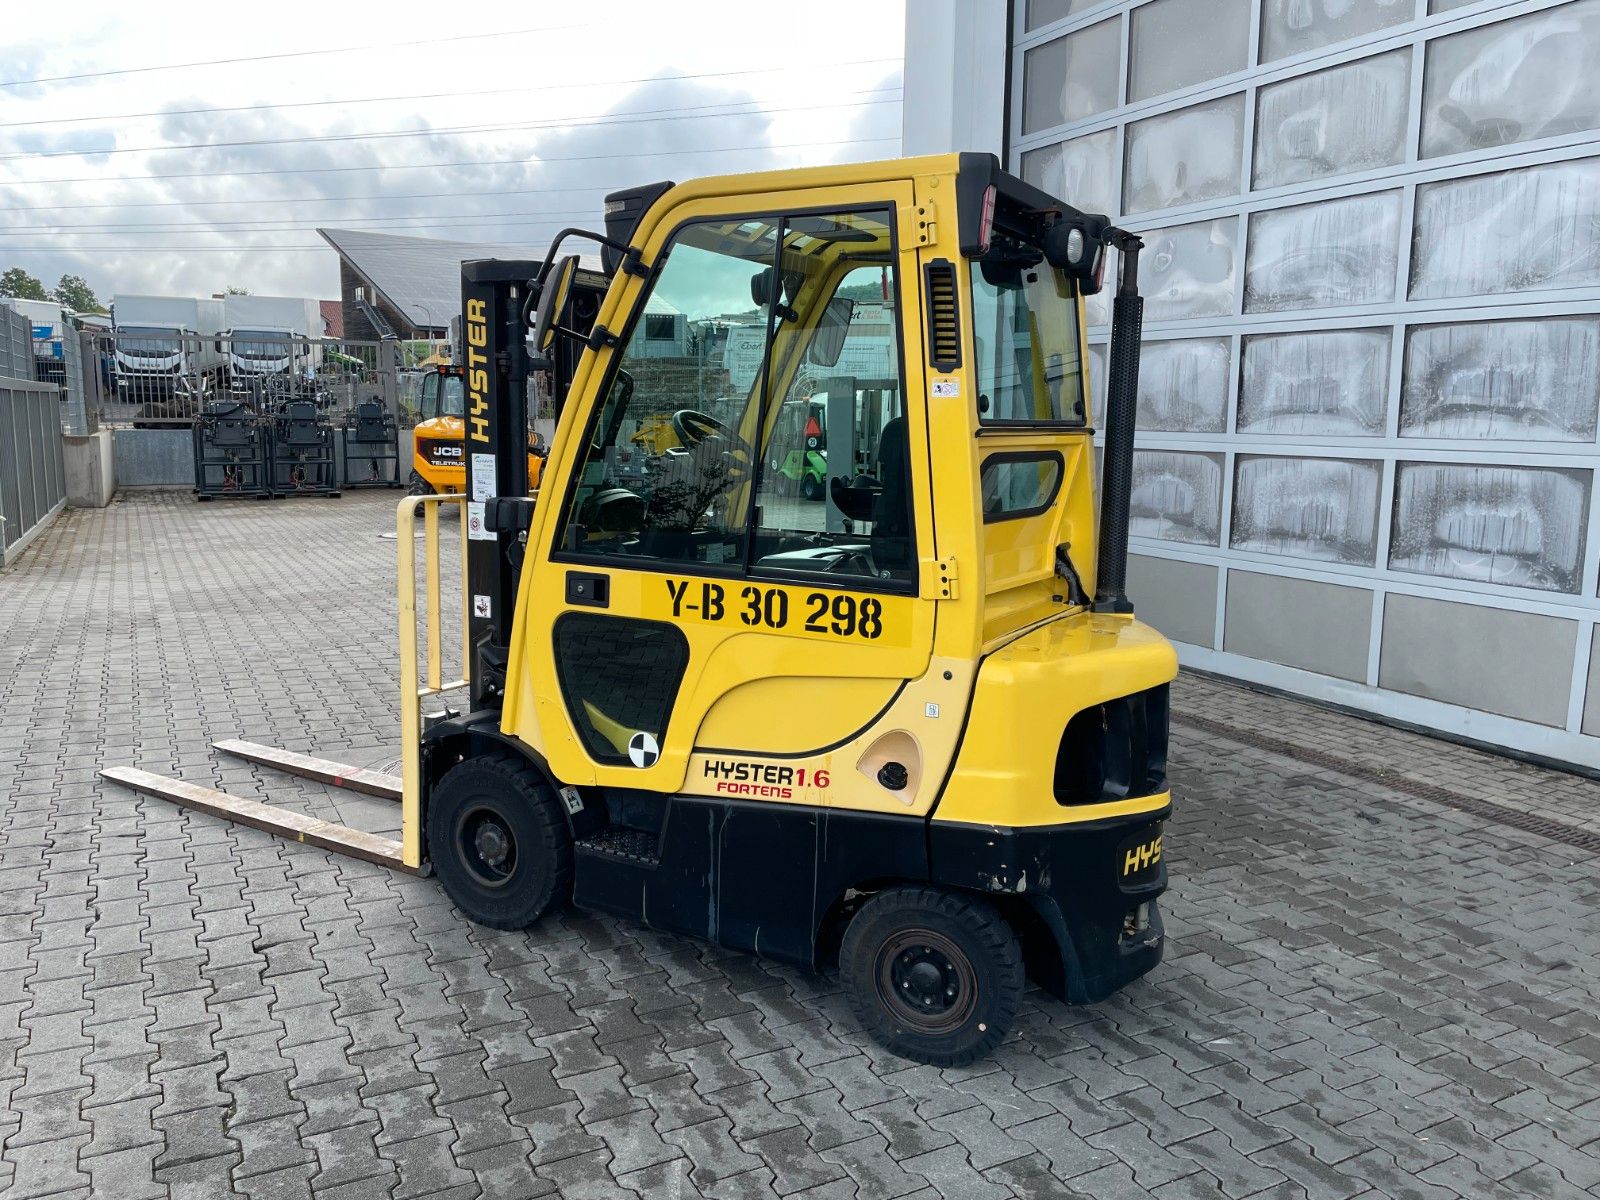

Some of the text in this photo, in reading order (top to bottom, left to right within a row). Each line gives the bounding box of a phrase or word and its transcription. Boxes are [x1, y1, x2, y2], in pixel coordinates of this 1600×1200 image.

[467, 298, 490, 443] HYSTER
[433, 447, 462, 456] JCB
[666, 579, 883, 639] Y-B 30 298
[703, 760, 831, 789] HYSTER 1.6
[716, 781, 793, 799] FORTENS
